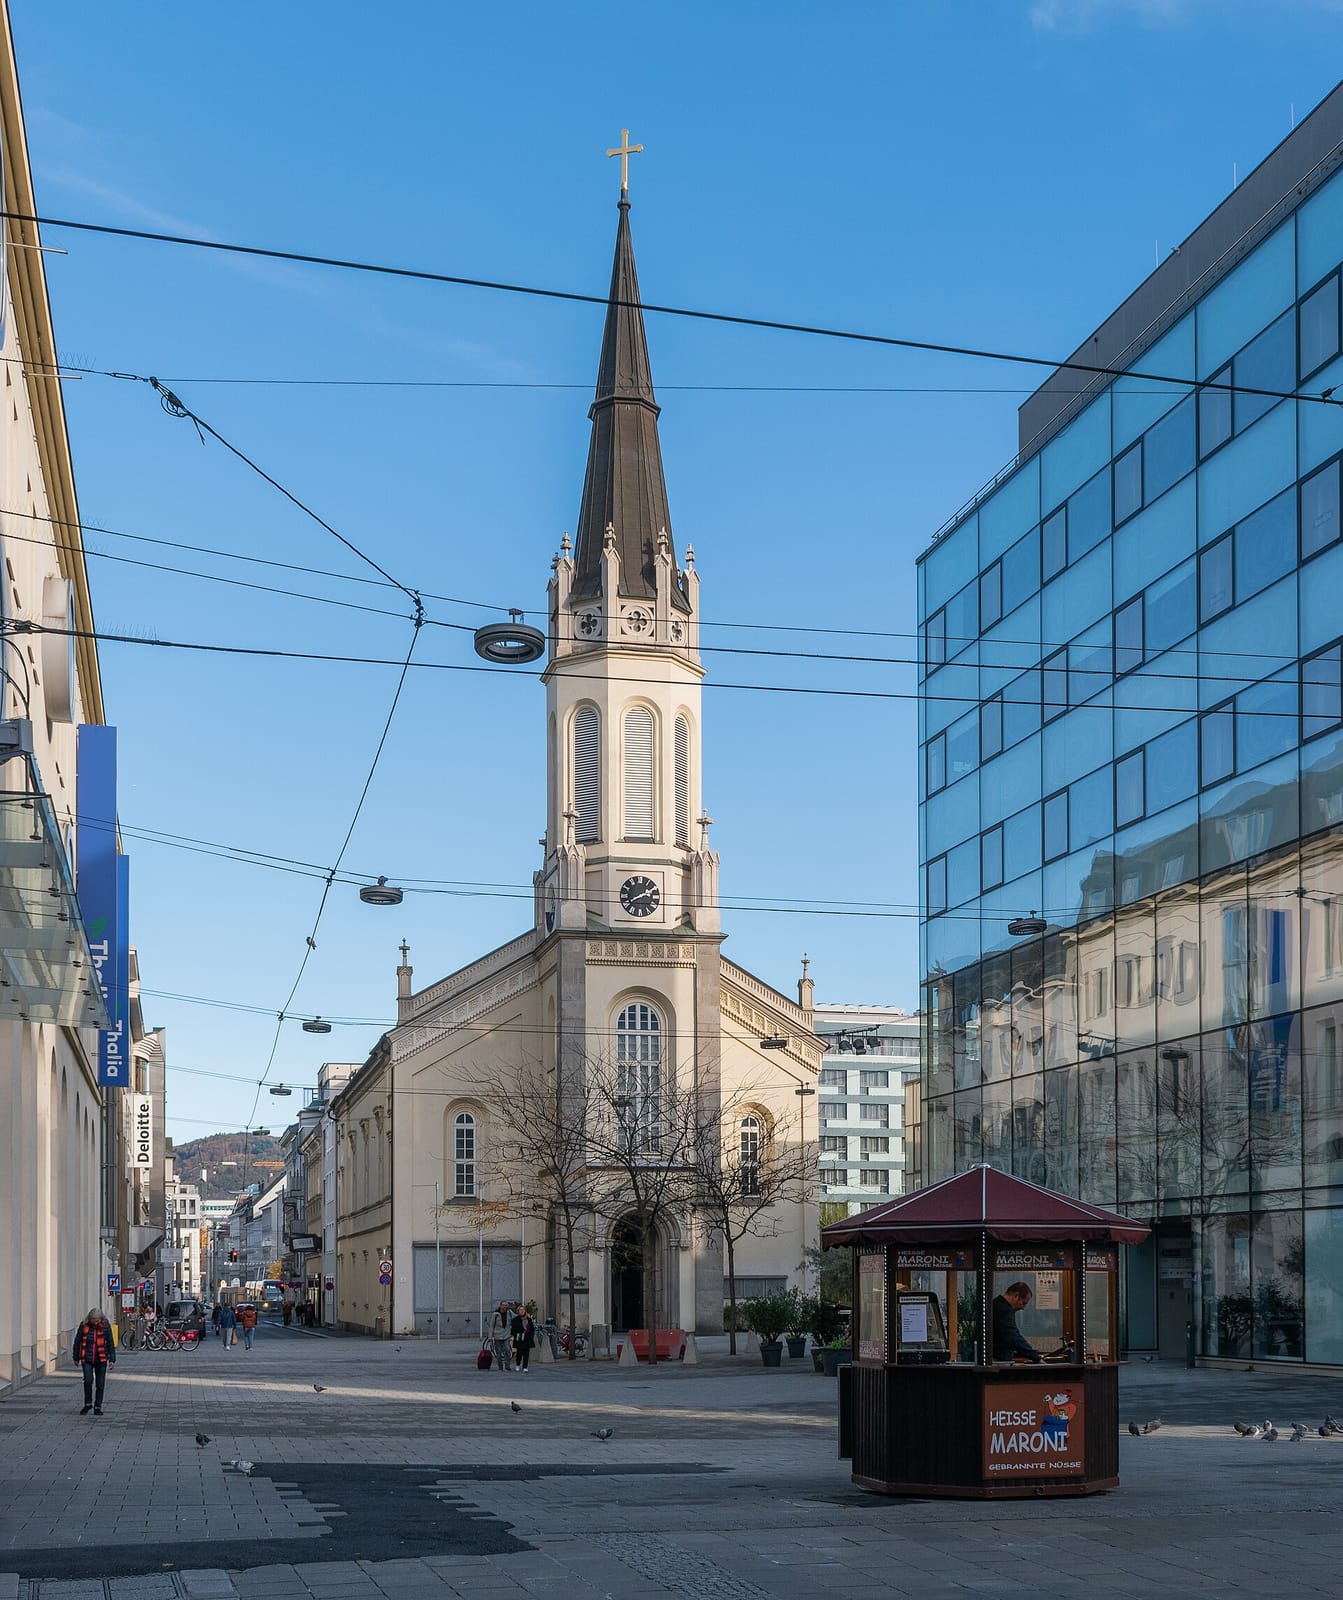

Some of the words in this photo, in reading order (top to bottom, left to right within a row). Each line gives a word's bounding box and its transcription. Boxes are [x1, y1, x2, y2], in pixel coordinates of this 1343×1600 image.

[107, 1019, 122, 1077] Thalia
[897, 1255, 949, 1264] MARONI
[996, 1255, 1049, 1264] MARONI
[989, 1410, 1037, 1426] HEISSE
[990, 1431, 1068, 1454] MARONI
[989, 1462, 1046, 1471] GEBRANNTE
[1049, 1461, 1081, 1469] NÜSSE
